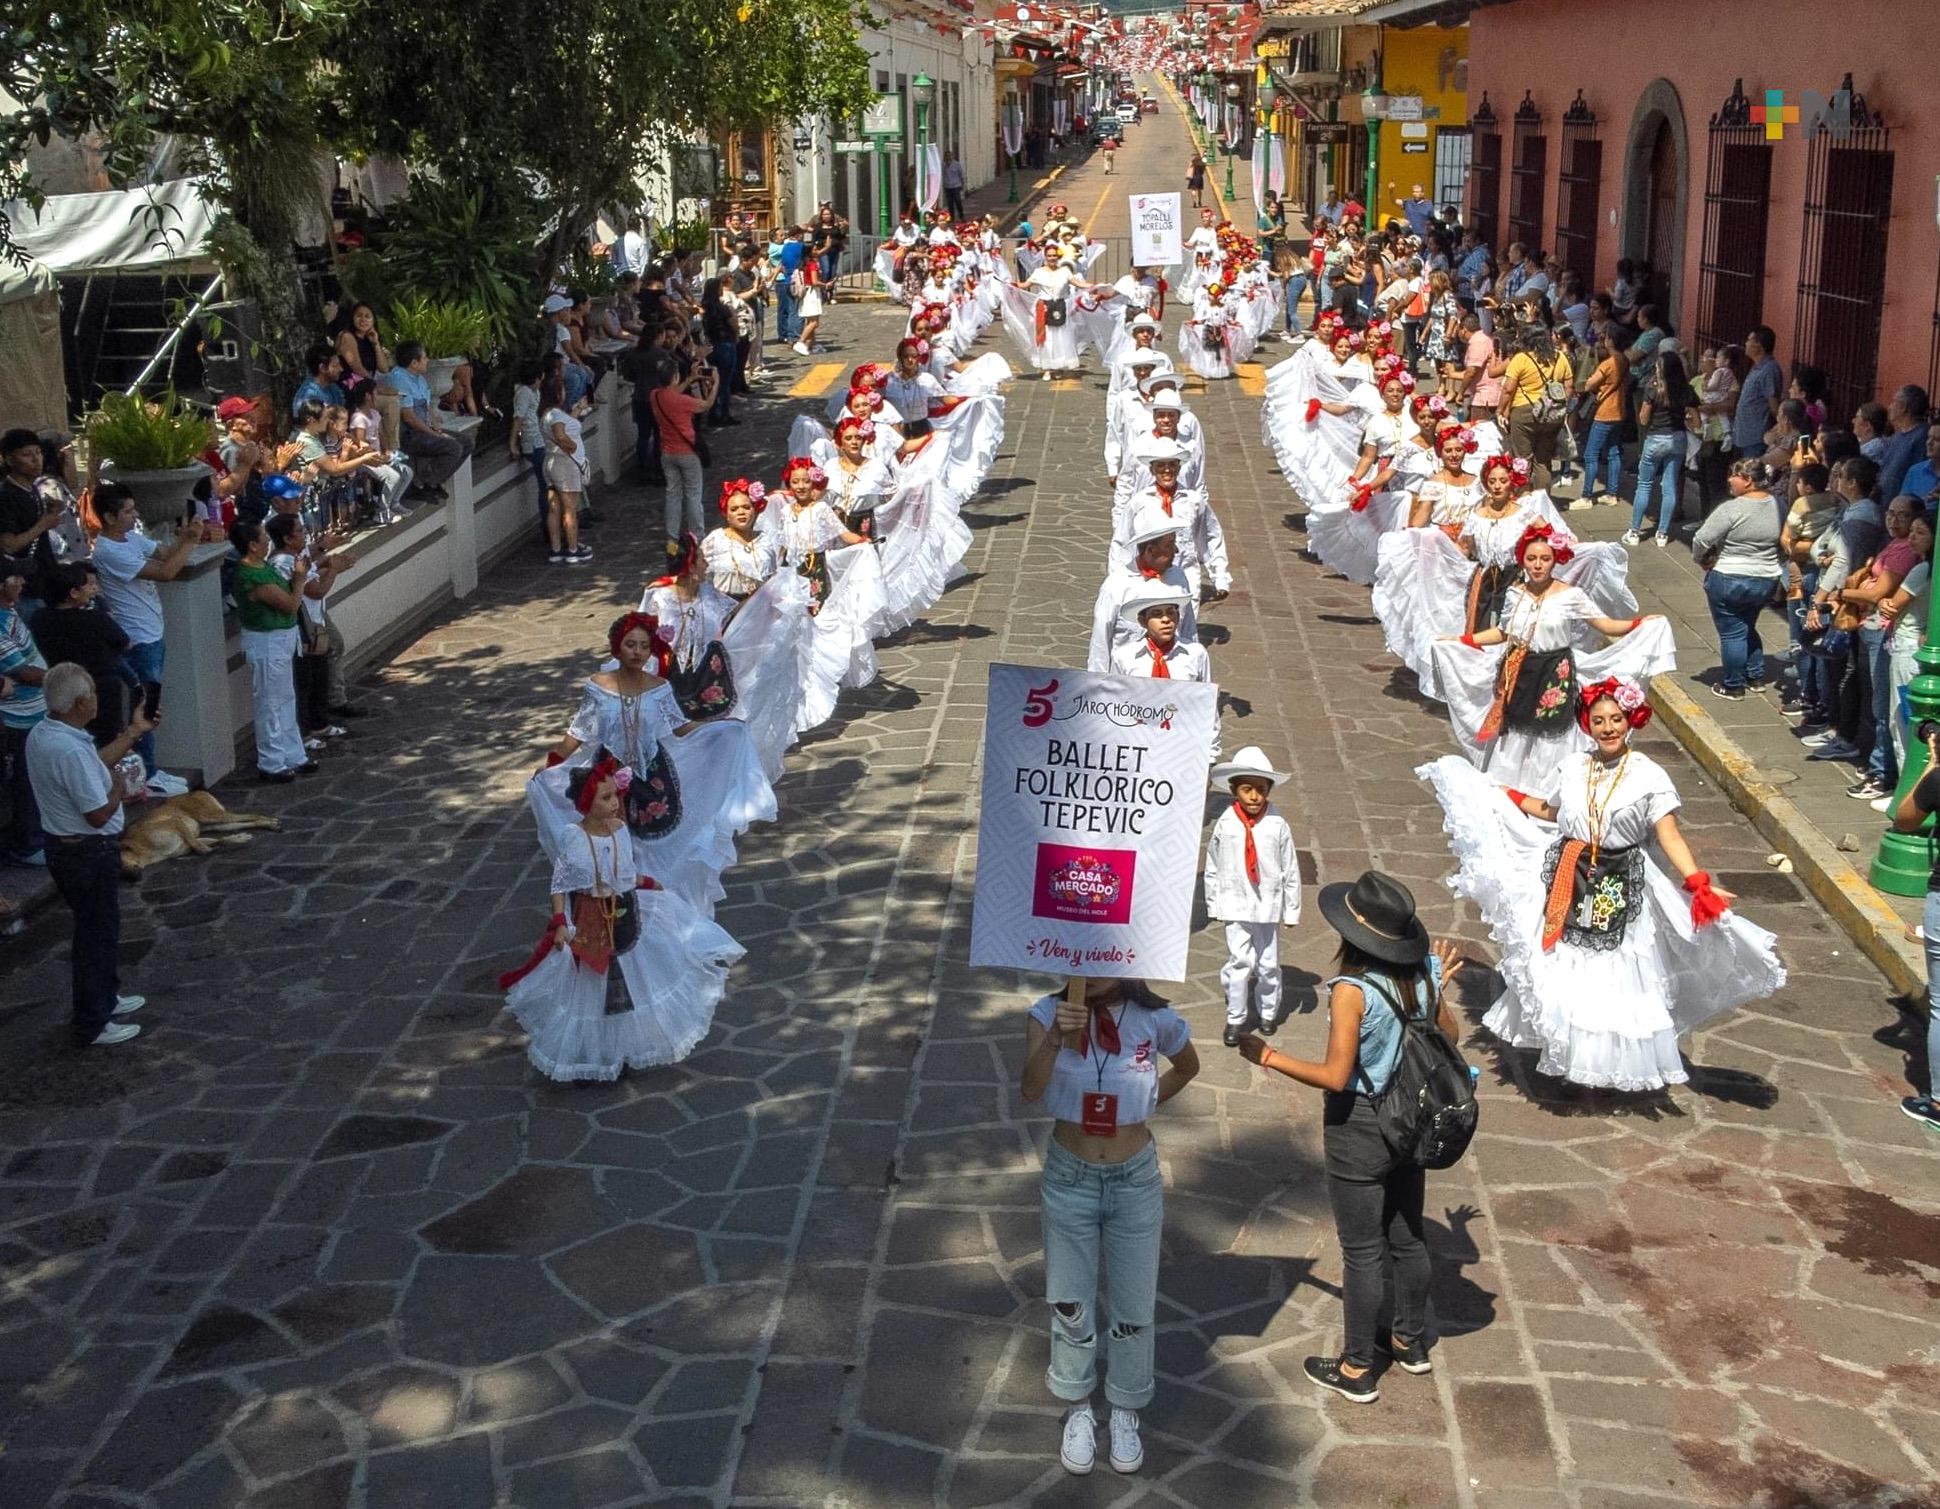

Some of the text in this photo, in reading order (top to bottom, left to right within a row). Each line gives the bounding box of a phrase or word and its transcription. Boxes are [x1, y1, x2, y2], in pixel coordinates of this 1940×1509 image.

[1139, 221, 1174, 231] MORELOS
[1046, 738, 1149, 773] BALLET
[1014, 767, 1174, 806] FOLKLÓRICO
[1039, 800, 1146, 835] TEPEVIC
[1055, 881, 1114, 896] MERCADO
[1069, 870, 1102, 882] CASA
[1040, 938, 1071, 958] Ven
[1069, 948, 1083, 967] y
